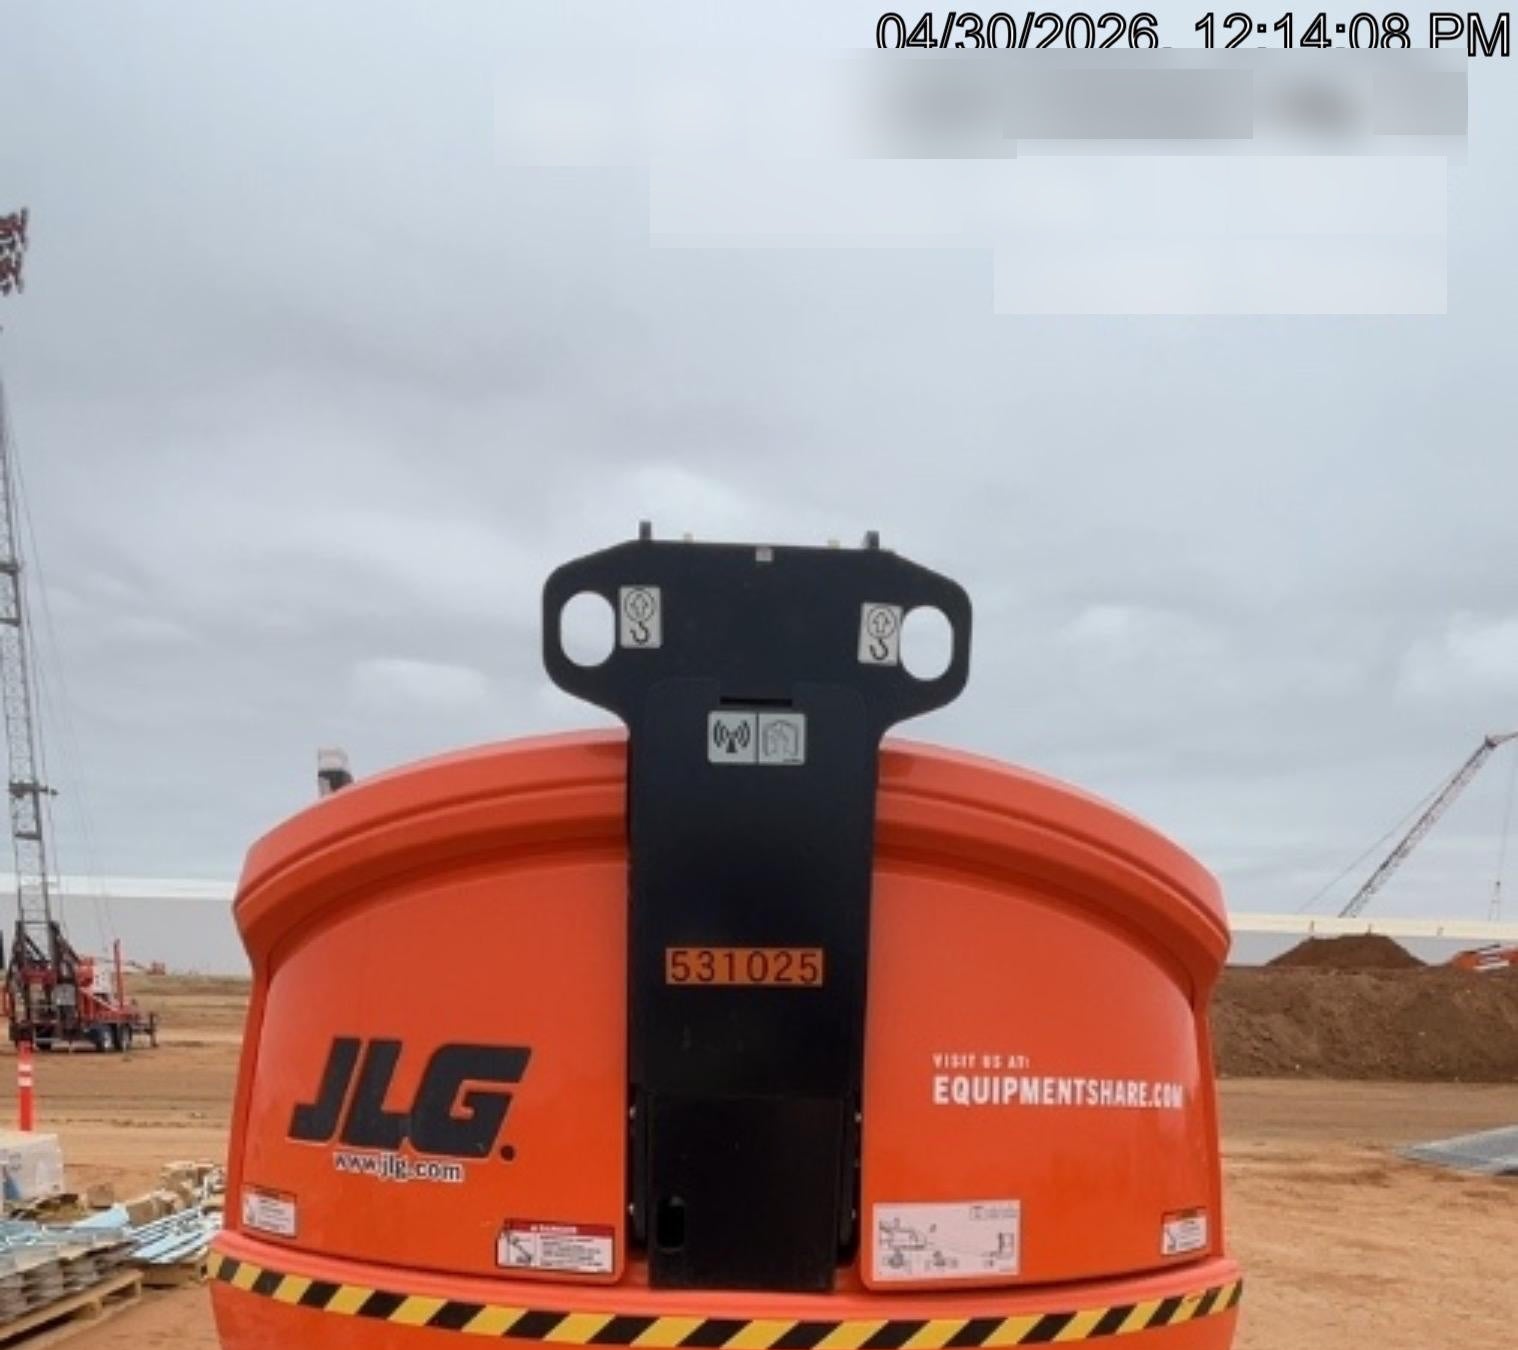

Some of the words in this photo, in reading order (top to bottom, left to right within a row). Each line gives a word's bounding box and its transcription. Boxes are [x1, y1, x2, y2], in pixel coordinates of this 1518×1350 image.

[670, 950, 818, 983] 531025
[932, 1052, 976, 1069] VISIT
[983, 1054, 1002, 1069] US
[933, 1075, 1184, 1109] EQUIPMENTSHARE.COM
